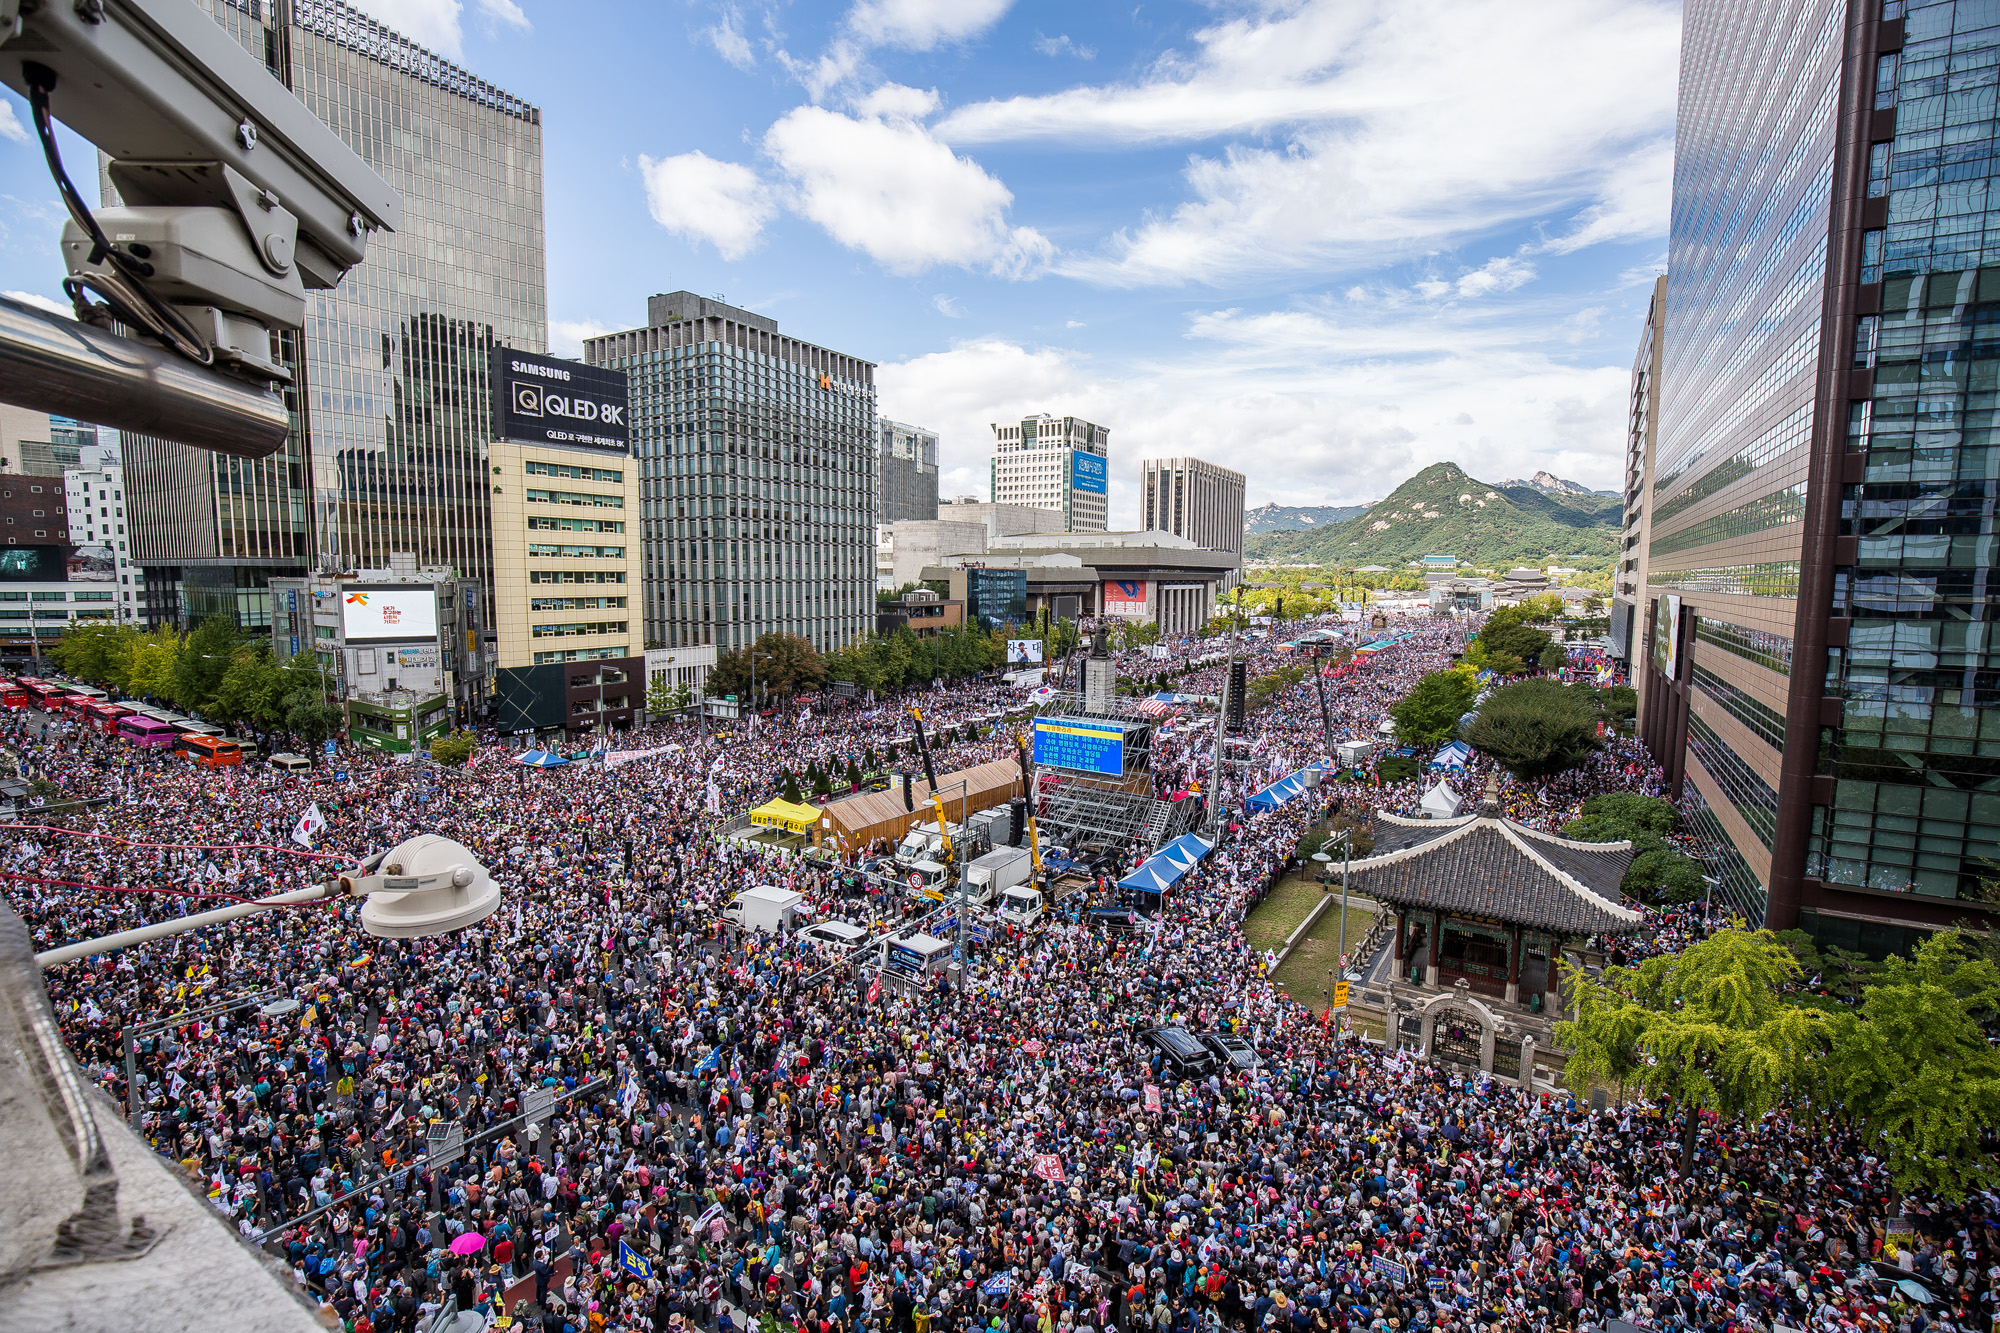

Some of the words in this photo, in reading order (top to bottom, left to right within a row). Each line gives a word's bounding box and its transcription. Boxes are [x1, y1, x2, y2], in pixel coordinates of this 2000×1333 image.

[511, 361, 571, 381] SAMSUNG
[519, 390, 539, 411] Q
[545, 394, 598, 420] QLED
[600, 404, 624, 426] 8K
[546, 430, 567, 440] QLED
[616, 440, 624, 448] 8K
[1059, 740, 1079, 748] 영원토록
[1082, 743, 1108, 752] 사랑하리라
[1095, 738, 1117, 746] 우리조국
[752, 816, 767, 824] 세월호
[788, 822, 804, 831] 재수사
[912, 876, 921, 884] 50
